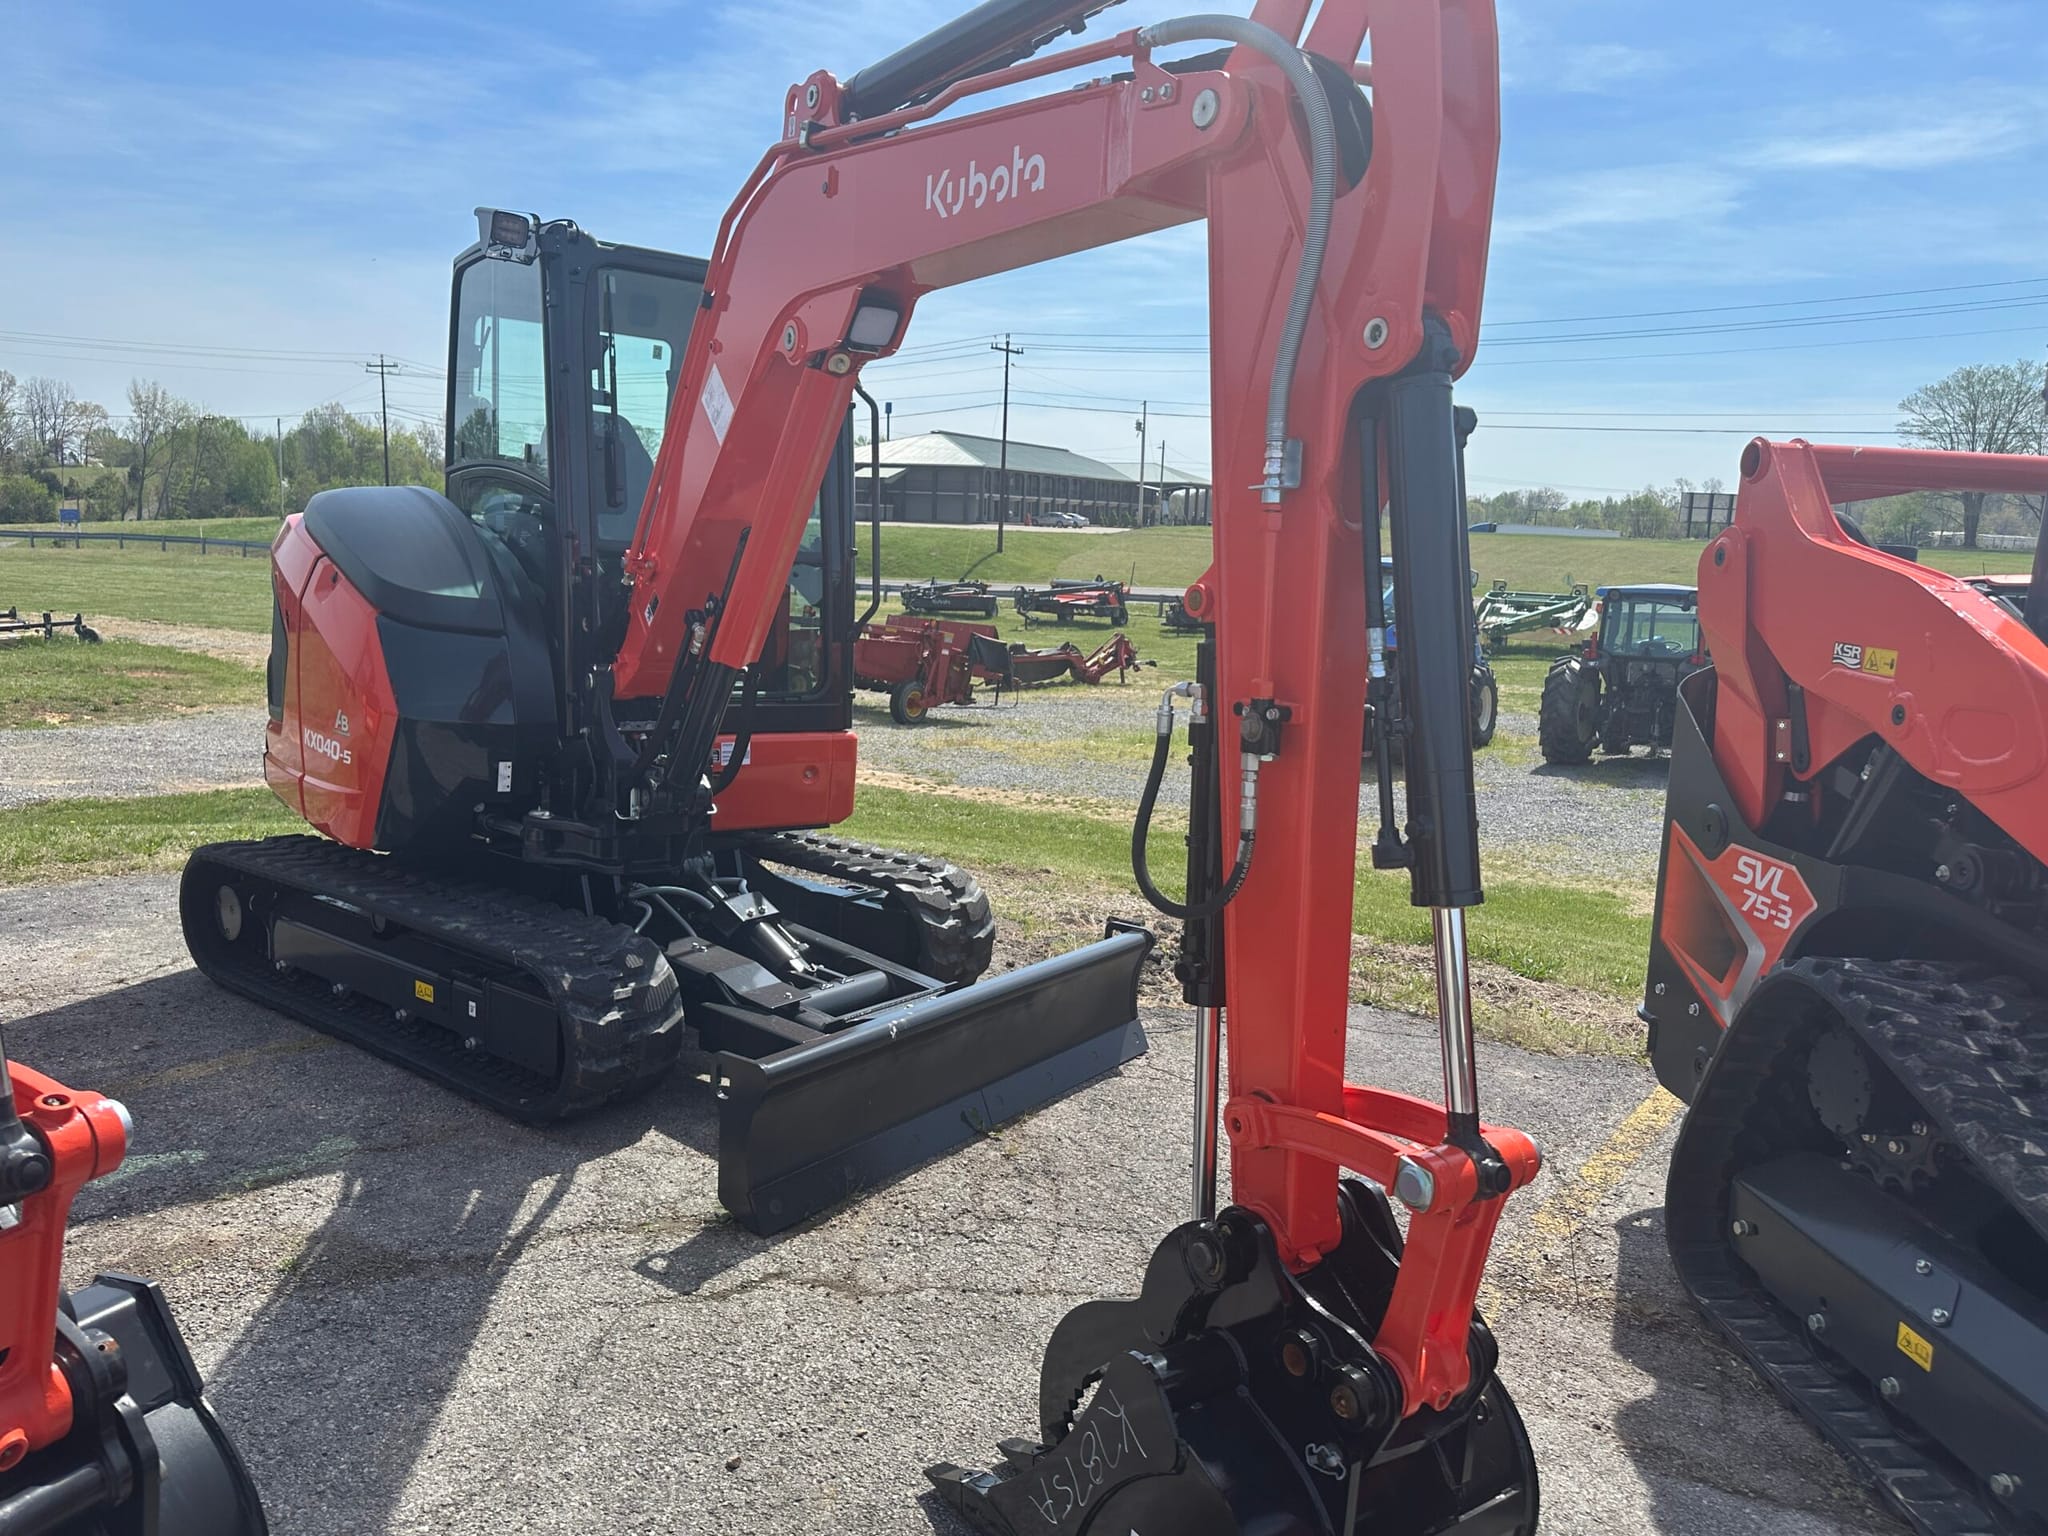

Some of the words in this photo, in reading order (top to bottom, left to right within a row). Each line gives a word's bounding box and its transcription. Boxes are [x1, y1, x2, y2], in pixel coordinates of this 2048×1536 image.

[925, 144, 1045, 218] Kubota
[1834, 642, 1862, 659] KSR
[304, 727, 352, 765] KX040-5
[1732, 855, 1790, 902] SVL
[1741, 888, 1793, 930] 75-3
